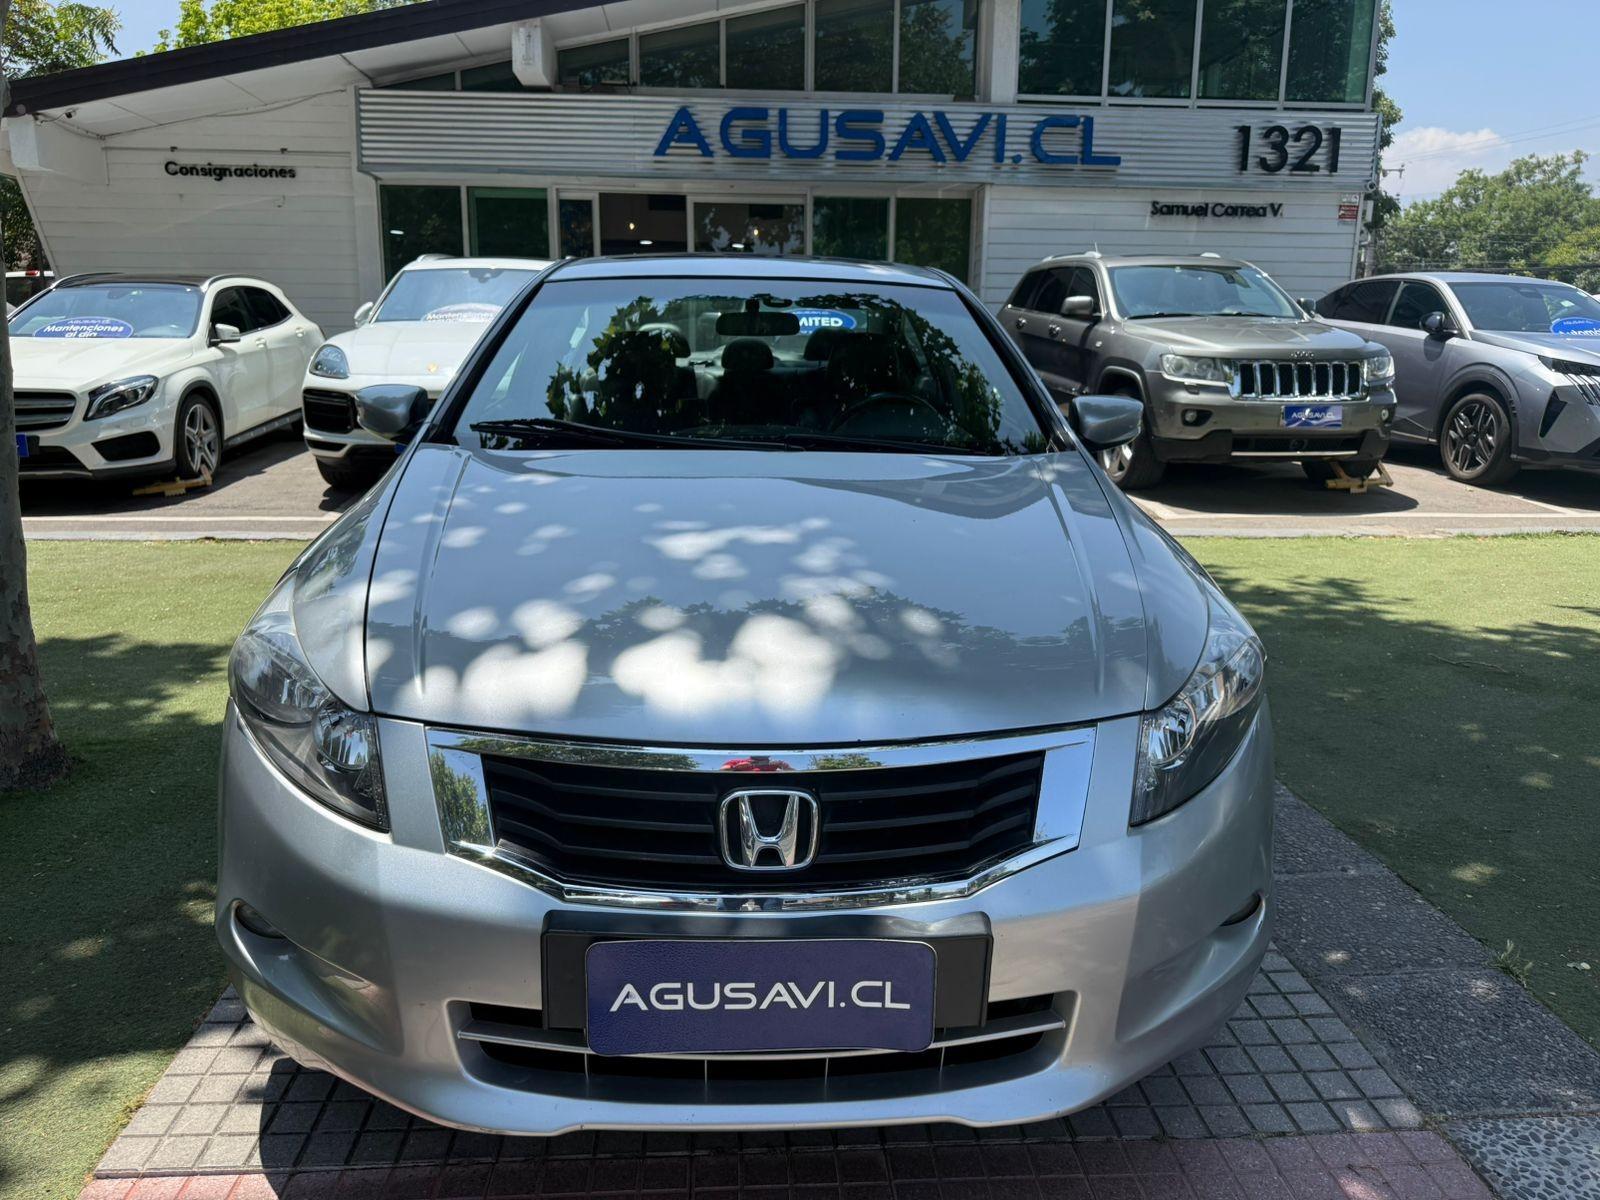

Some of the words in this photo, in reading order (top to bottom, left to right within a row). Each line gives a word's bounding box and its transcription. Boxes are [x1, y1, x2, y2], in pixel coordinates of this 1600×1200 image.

[653, 105, 1122, 166] AGUSAVI.CL
[1236, 125, 1342, 174] 1321
[164, 161, 297, 181] Consignaciones
[1151, 201, 1208, 217] Samuel
[1211, 202, 1267, 217] Correa
[43, 324, 125, 333] Mantenciones
[610, 981, 911, 1012] AGUSAVI.CL
